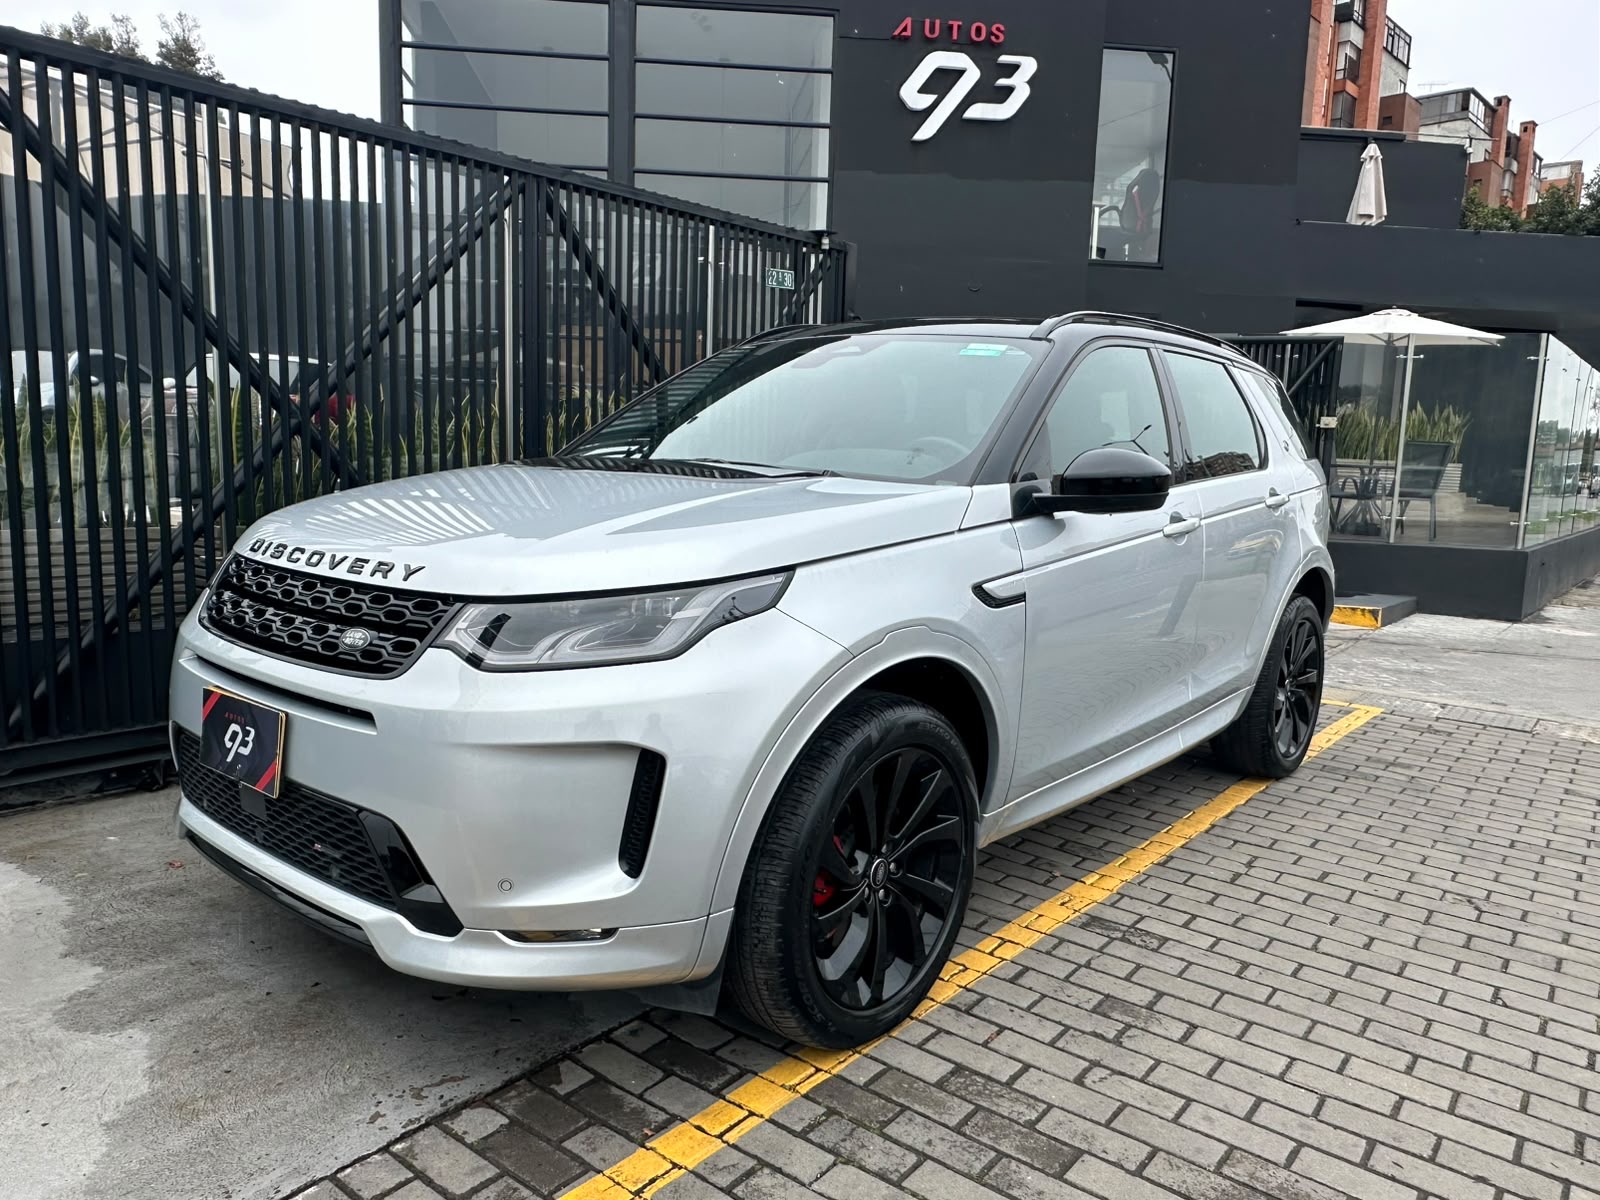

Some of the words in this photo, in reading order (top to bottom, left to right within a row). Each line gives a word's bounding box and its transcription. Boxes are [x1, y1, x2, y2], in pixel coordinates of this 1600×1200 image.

[892, 17, 1005, 43] AUTOS
[899, 51, 1038, 141] 93
[249, 538, 426, 581] DISCOVERY
[224, 723, 256, 762] 93
